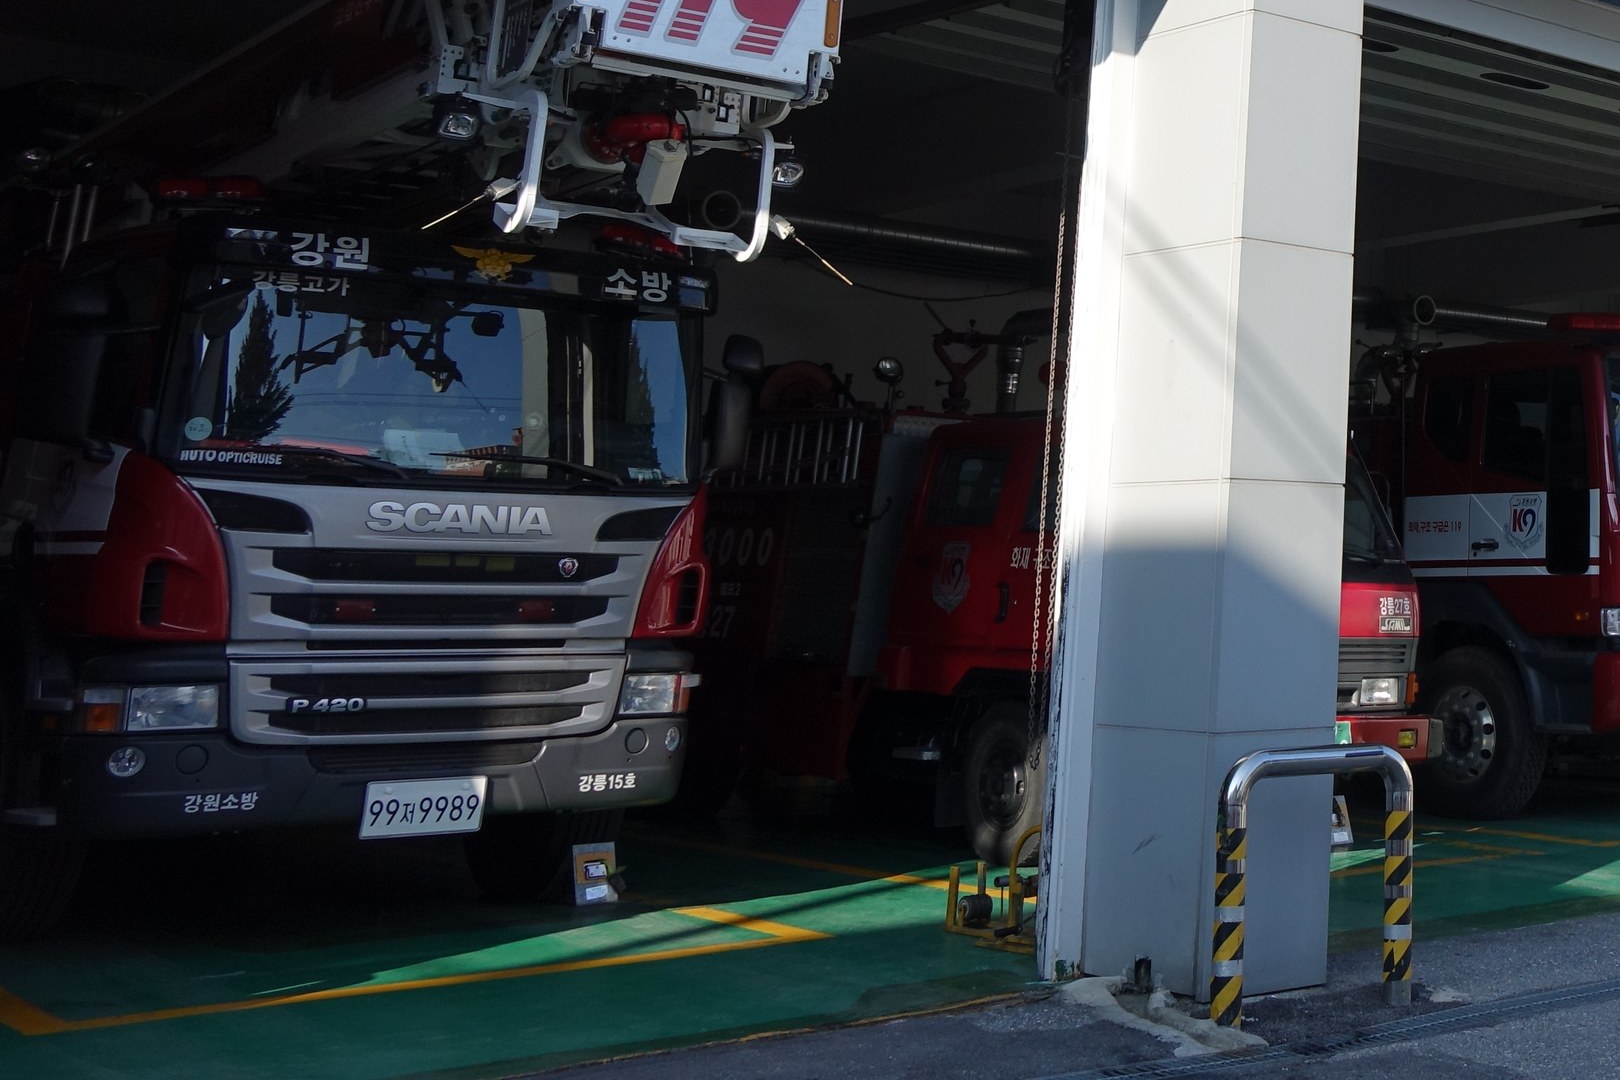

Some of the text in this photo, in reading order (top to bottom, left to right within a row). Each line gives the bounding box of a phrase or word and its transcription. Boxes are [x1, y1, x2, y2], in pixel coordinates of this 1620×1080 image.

[289, 231, 673, 303] 강원 소방
[252, 270, 351, 297] 강릉고가
[180, 449, 283, 466] AUTO OPTICRUISE
[364, 500, 553, 536] SCANIA
[1010, 546, 1031, 570] 화재
[1379, 596, 1411, 616] 강릉27호
[291, 697, 365, 714] P 420
[578, 772, 636, 793] 강릉15호
[184, 791, 260, 814] 강원소방
[368, 793, 480, 828] 99저9989
